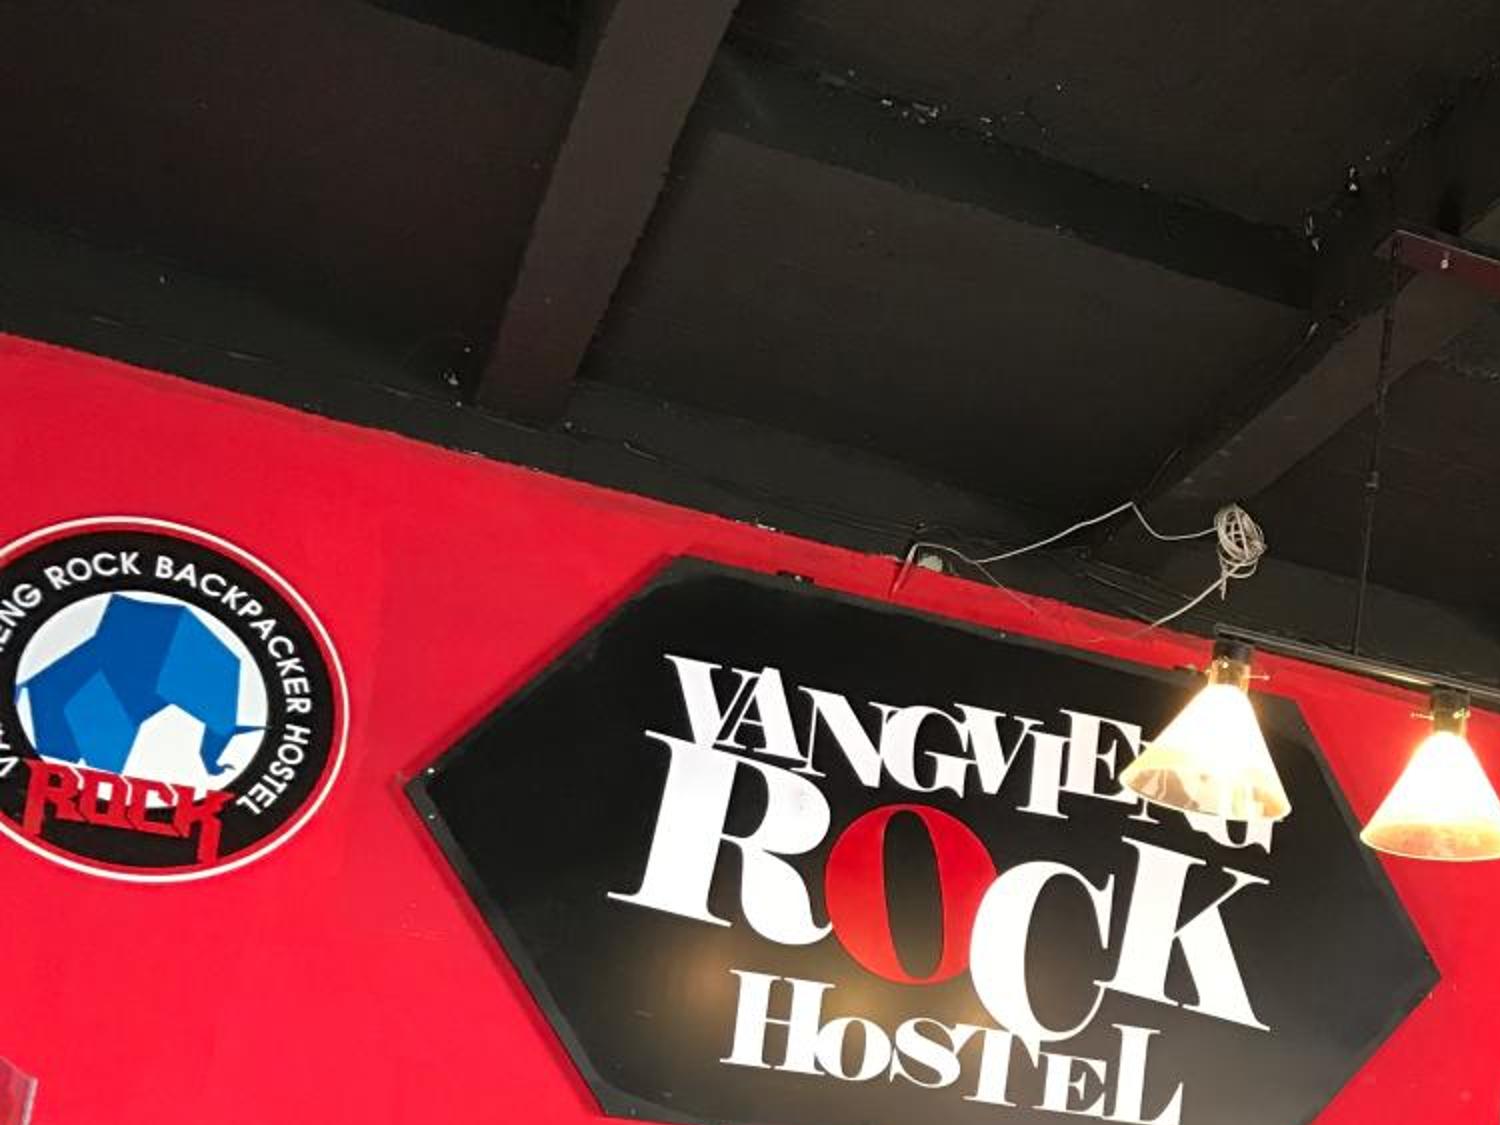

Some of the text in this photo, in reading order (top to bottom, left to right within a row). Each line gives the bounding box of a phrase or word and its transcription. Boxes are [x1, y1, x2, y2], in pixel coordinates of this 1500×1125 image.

[22, 758, 237, 866] ROCK
[44, 551, 142, 592] ROCK
[155, 555, 312, 715] BACKPACKER
[236, 723, 312, 815] HOSTEL
[608, 730, 1271, 1043] ROCK
